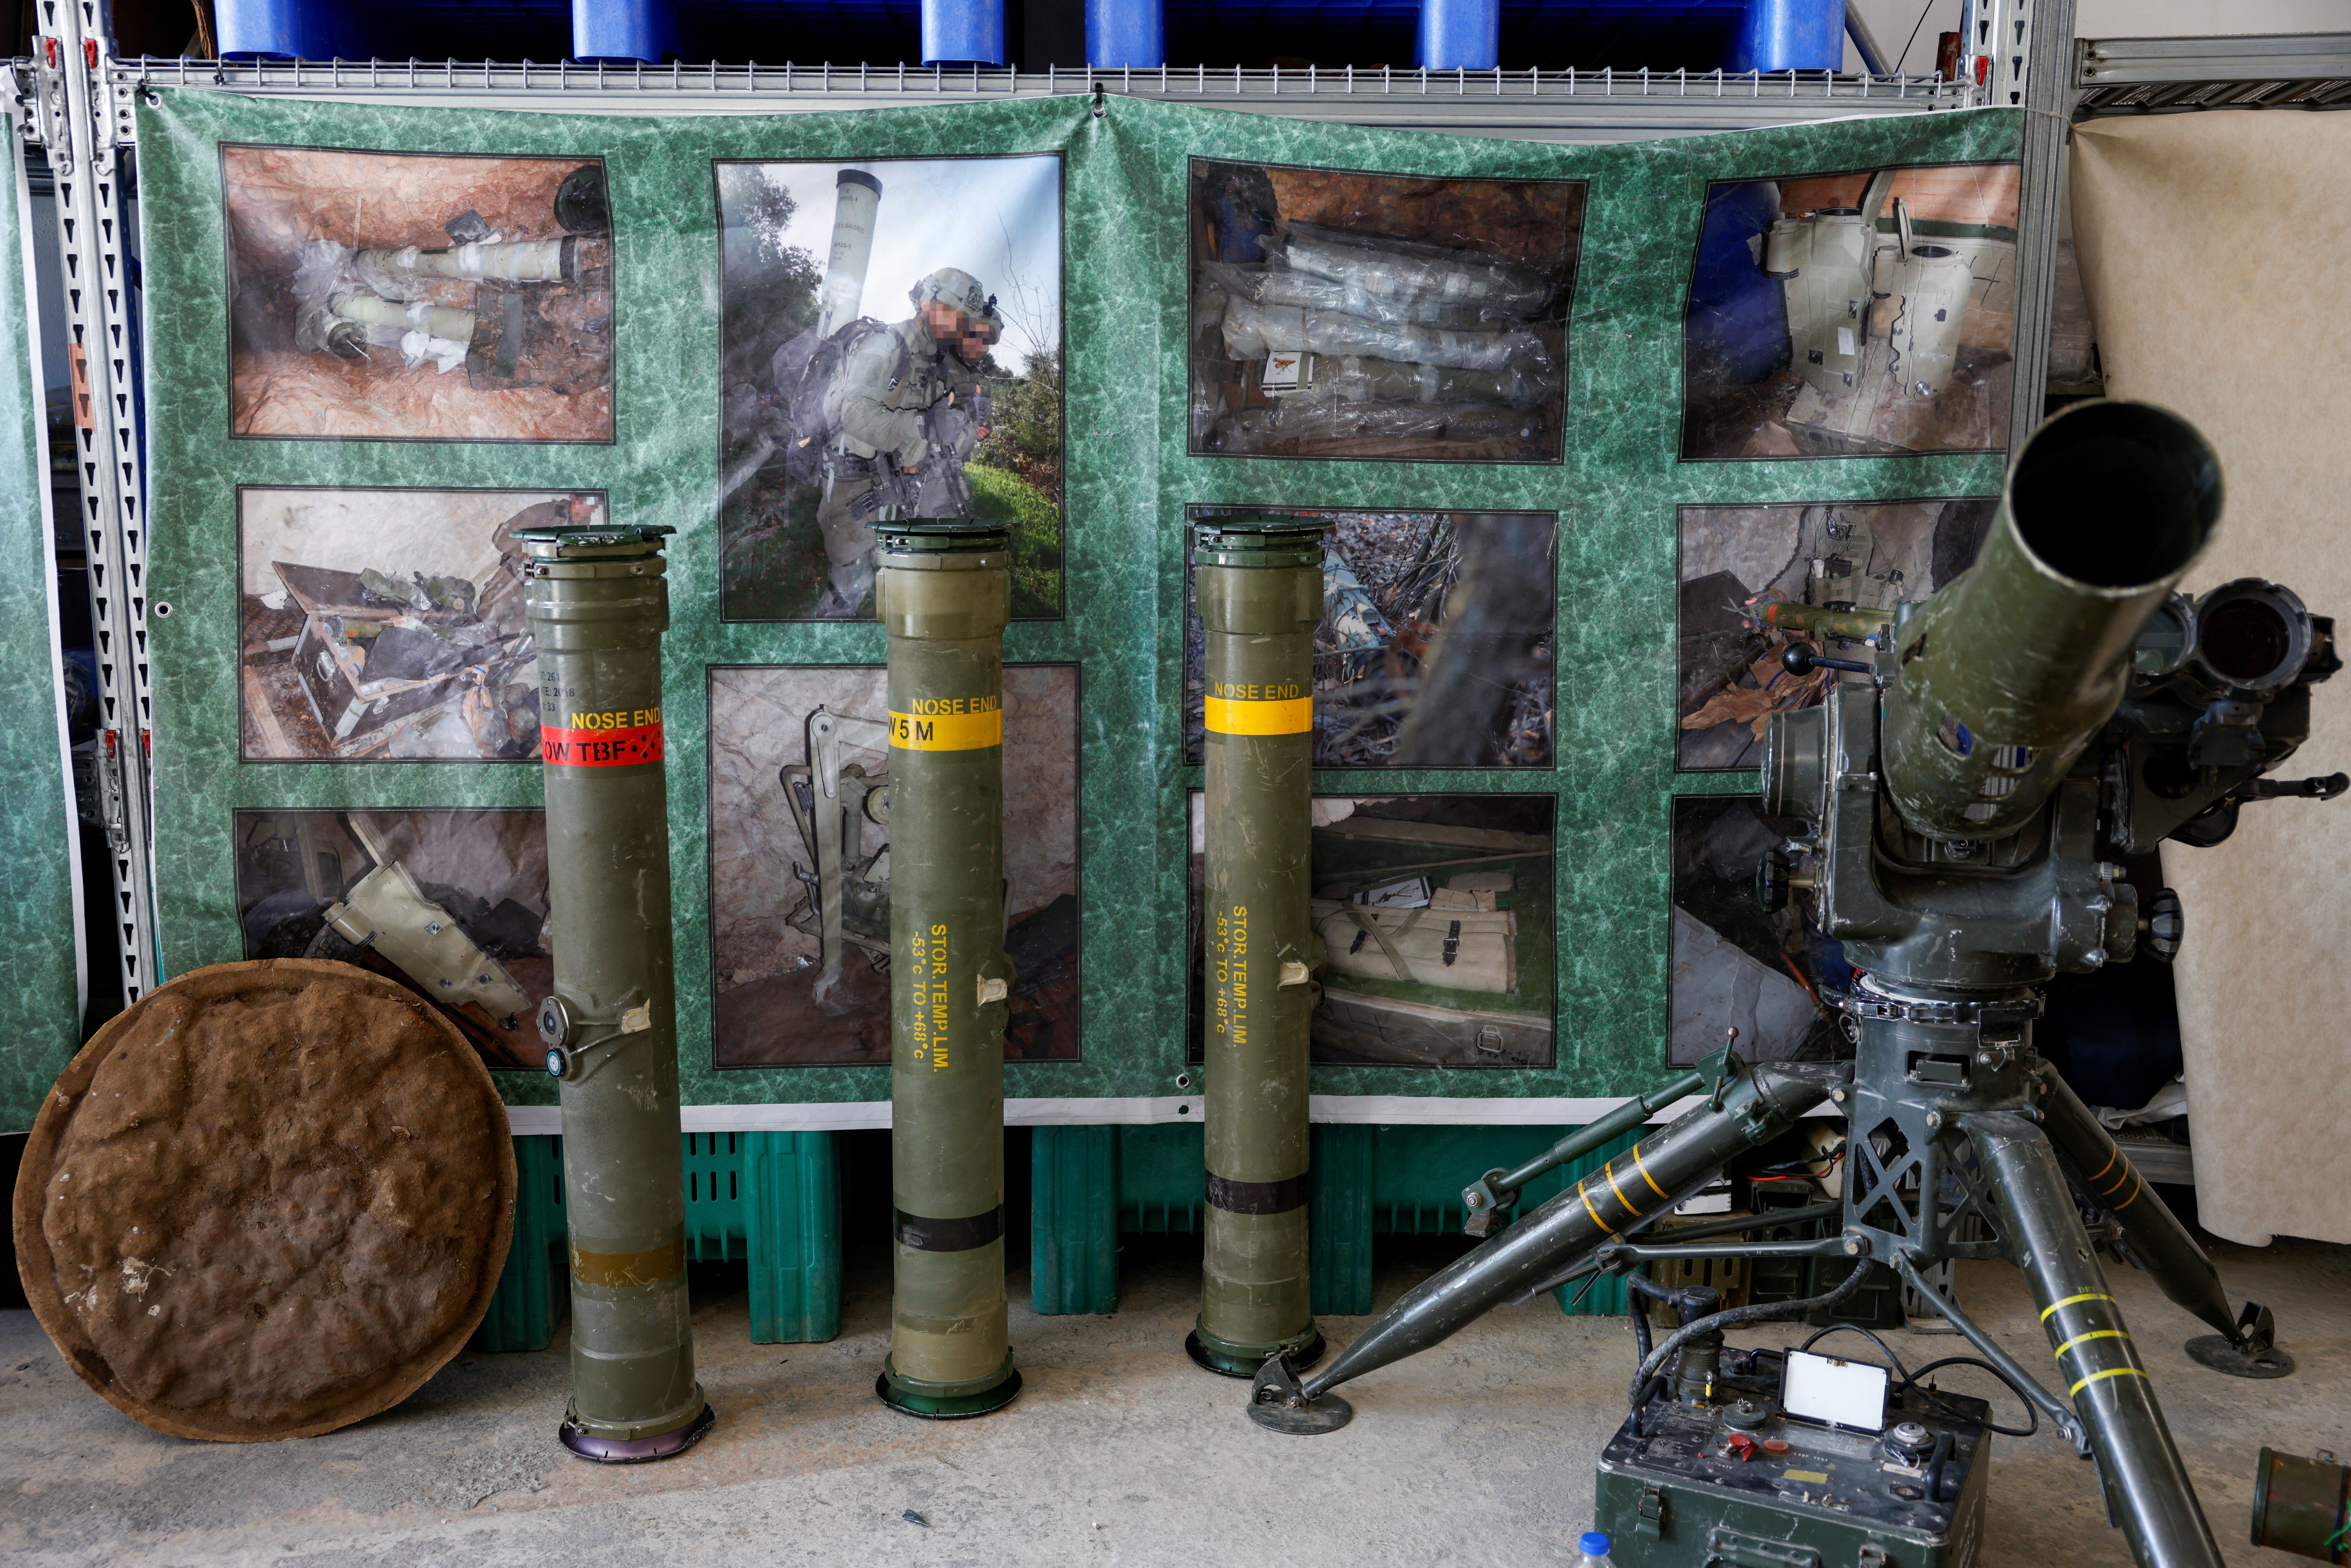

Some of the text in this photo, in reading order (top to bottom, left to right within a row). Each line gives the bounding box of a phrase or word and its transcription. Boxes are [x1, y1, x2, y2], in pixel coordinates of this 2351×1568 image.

[1214, 681, 1299, 700] NOSE END
[547, 702, 555, 711] 33
[912, 695, 997, 715] NOSE END
[572, 707, 660, 730] NOSE END
[900, 719, 909, 740] 5
[916, 721, 933, 741] M
[576, 740, 627, 761] TBF
[1217, 959, 1228, 982] TO
[913, 981, 927, 1005] TO
